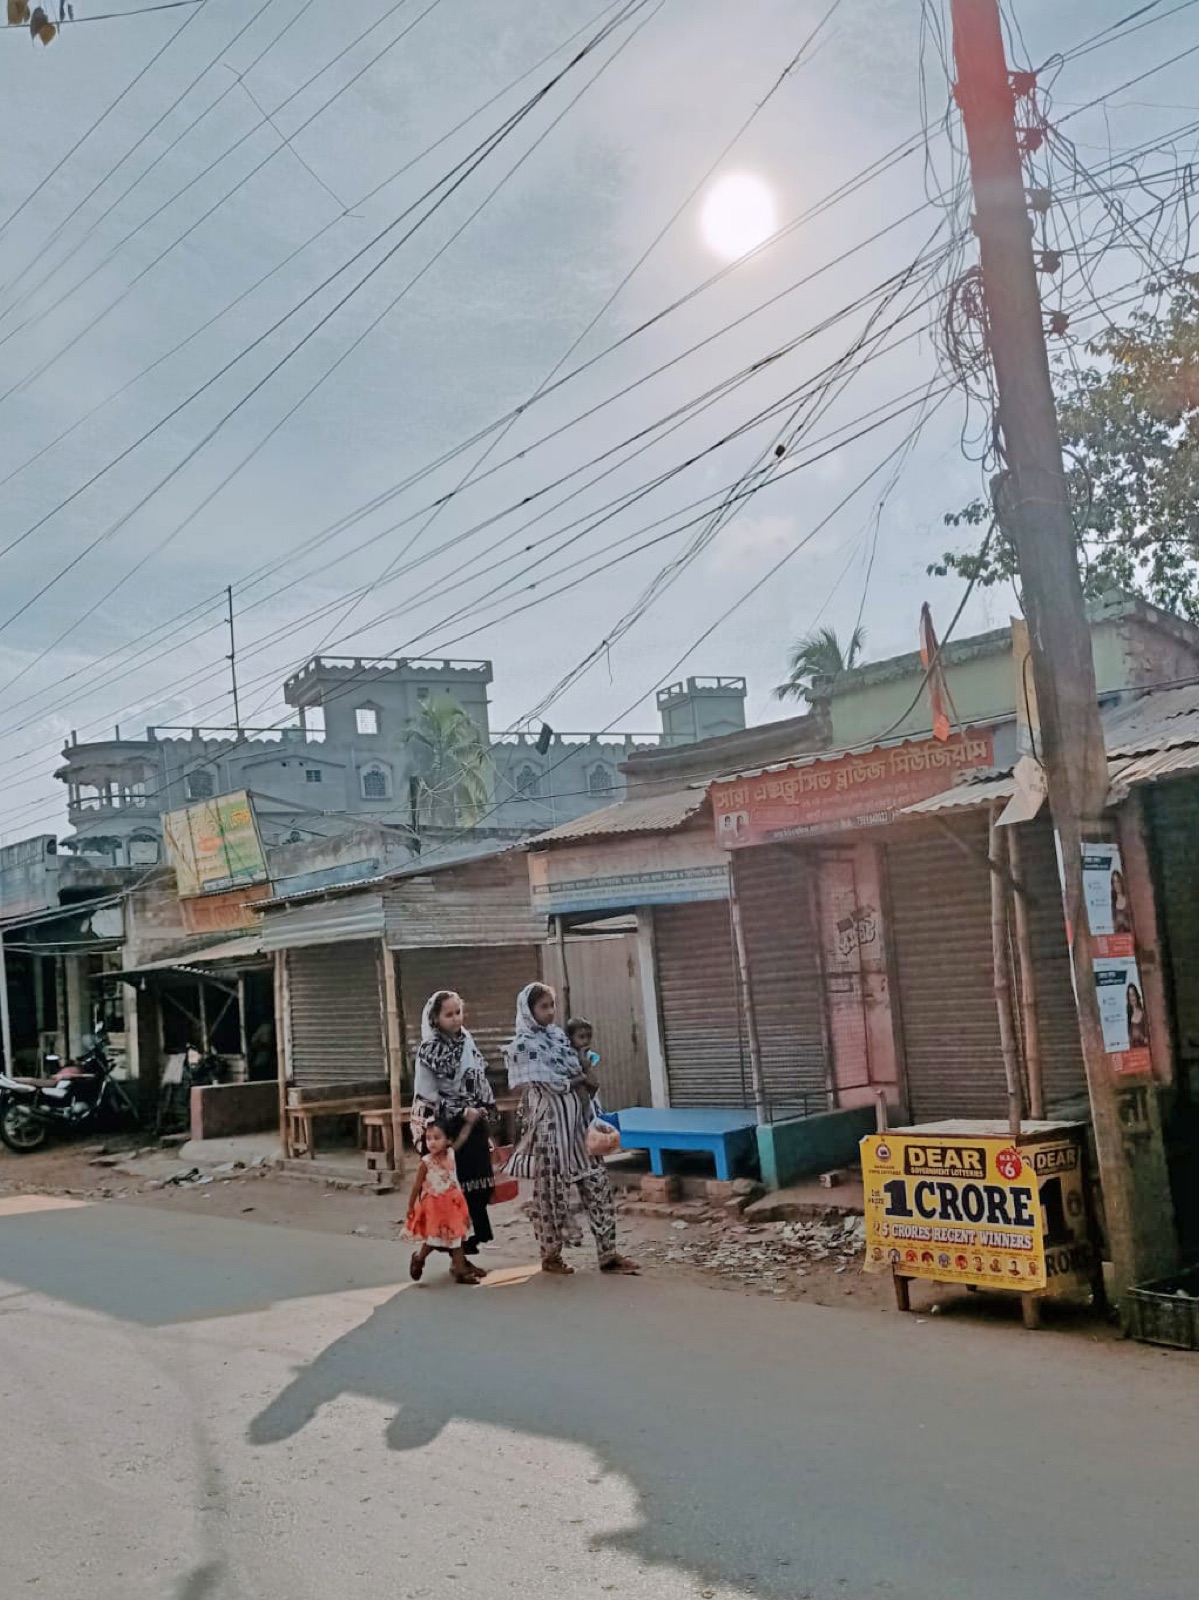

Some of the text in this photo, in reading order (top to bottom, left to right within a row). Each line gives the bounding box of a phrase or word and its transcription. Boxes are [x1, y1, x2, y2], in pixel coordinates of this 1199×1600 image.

[717, 786, 750, 808] সারা
[909, 1147, 981, 1170] DEAR
[1036, 1148, 1076, 1169] DEAR
[915, 1180, 1035, 1227] CRORE
[891, 1223, 932, 1241] CRORES
[933, 1226, 977, 1246] RECENT
[979, 1230, 1033, 1250] WINNERS
